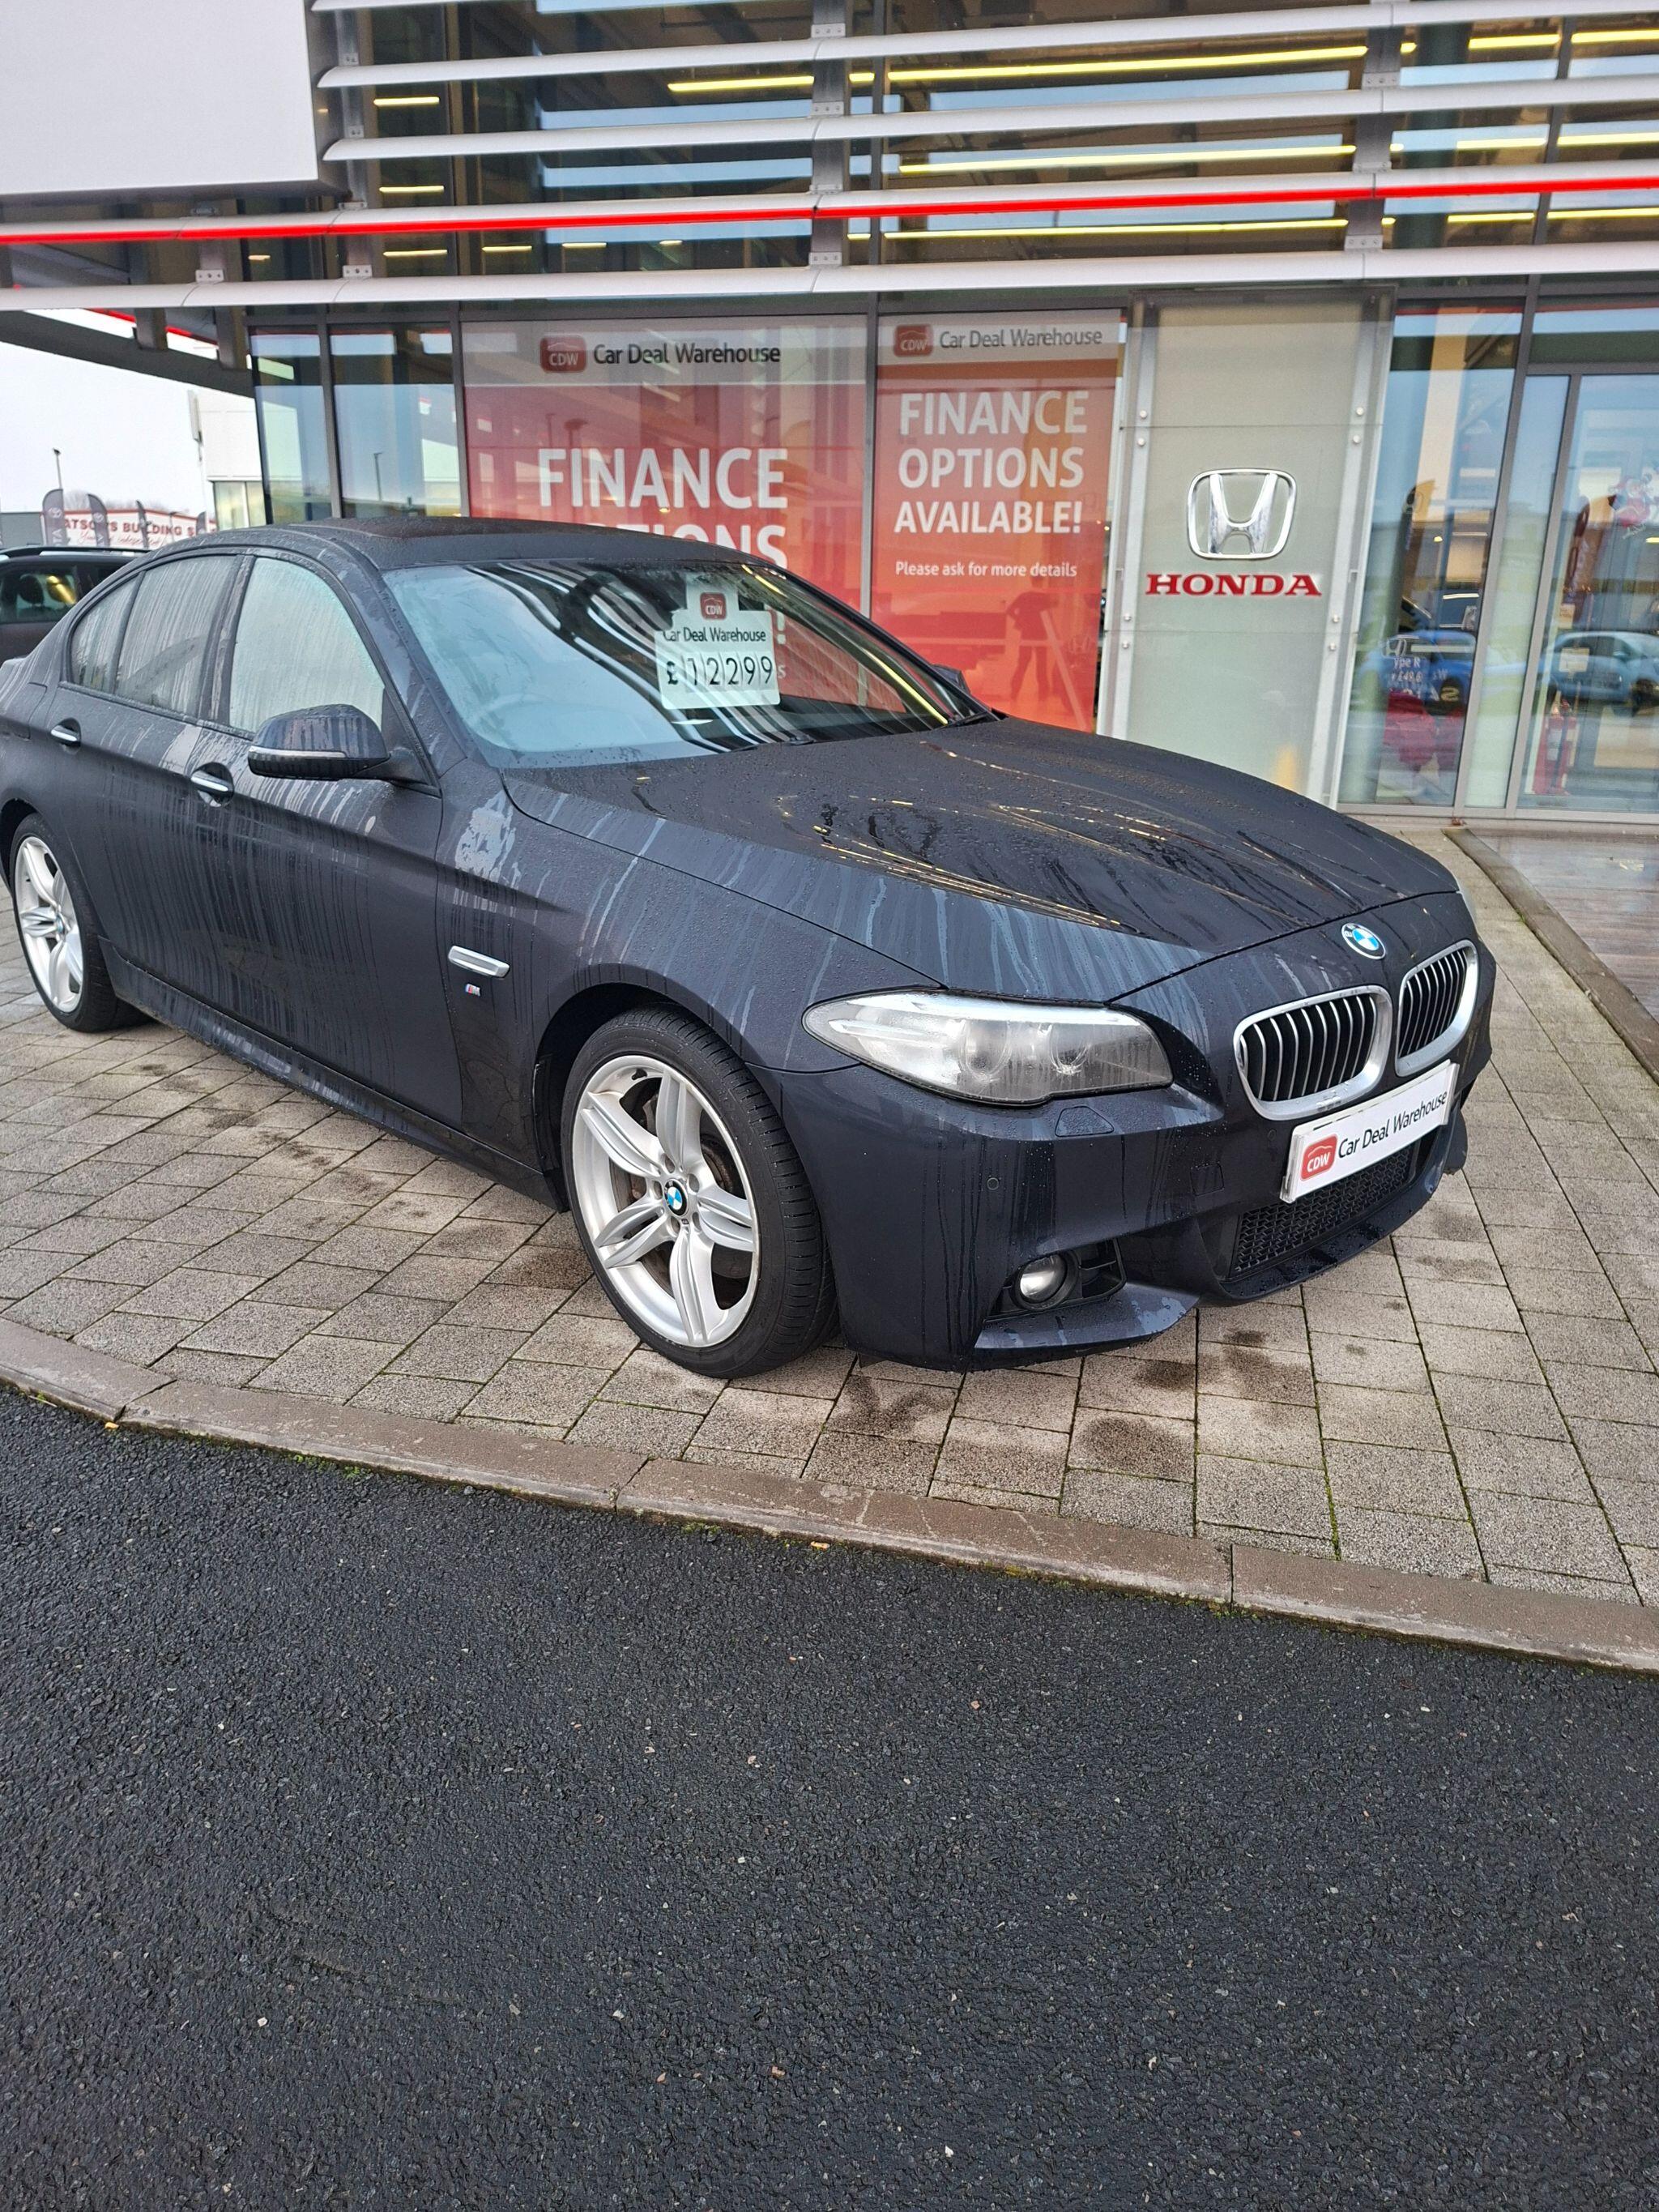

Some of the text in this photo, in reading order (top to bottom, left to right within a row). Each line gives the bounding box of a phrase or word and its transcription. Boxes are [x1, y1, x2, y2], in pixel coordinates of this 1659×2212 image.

[900, 339, 928, 352] CDW
[940, 327, 1102, 349] Car Deal Warehouse
[548, 352, 579, 366] CDW
[593, 342, 781, 365] Car Deal Warehouse
[900, 390, 1090, 435] FINANCE
[537, 447, 789, 510] FINANCE
[898, 446, 1085, 489] OPTIONS
[893, 500, 1083, 535] AVAILABLE!
[895, 561, 1077, 578] Please ask for more details
[1145, 573, 1323, 596] HONDA
[705, 604, 723, 616] CDW
[663, 629, 681, 642] Car
[683, 626, 707, 643] Deal
[710, 626, 766, 643] Warehouse
[1337, 1091, 1448, 1159] Car Deal Warehouse
[1307, 1151, 1331, 1173] CDW
